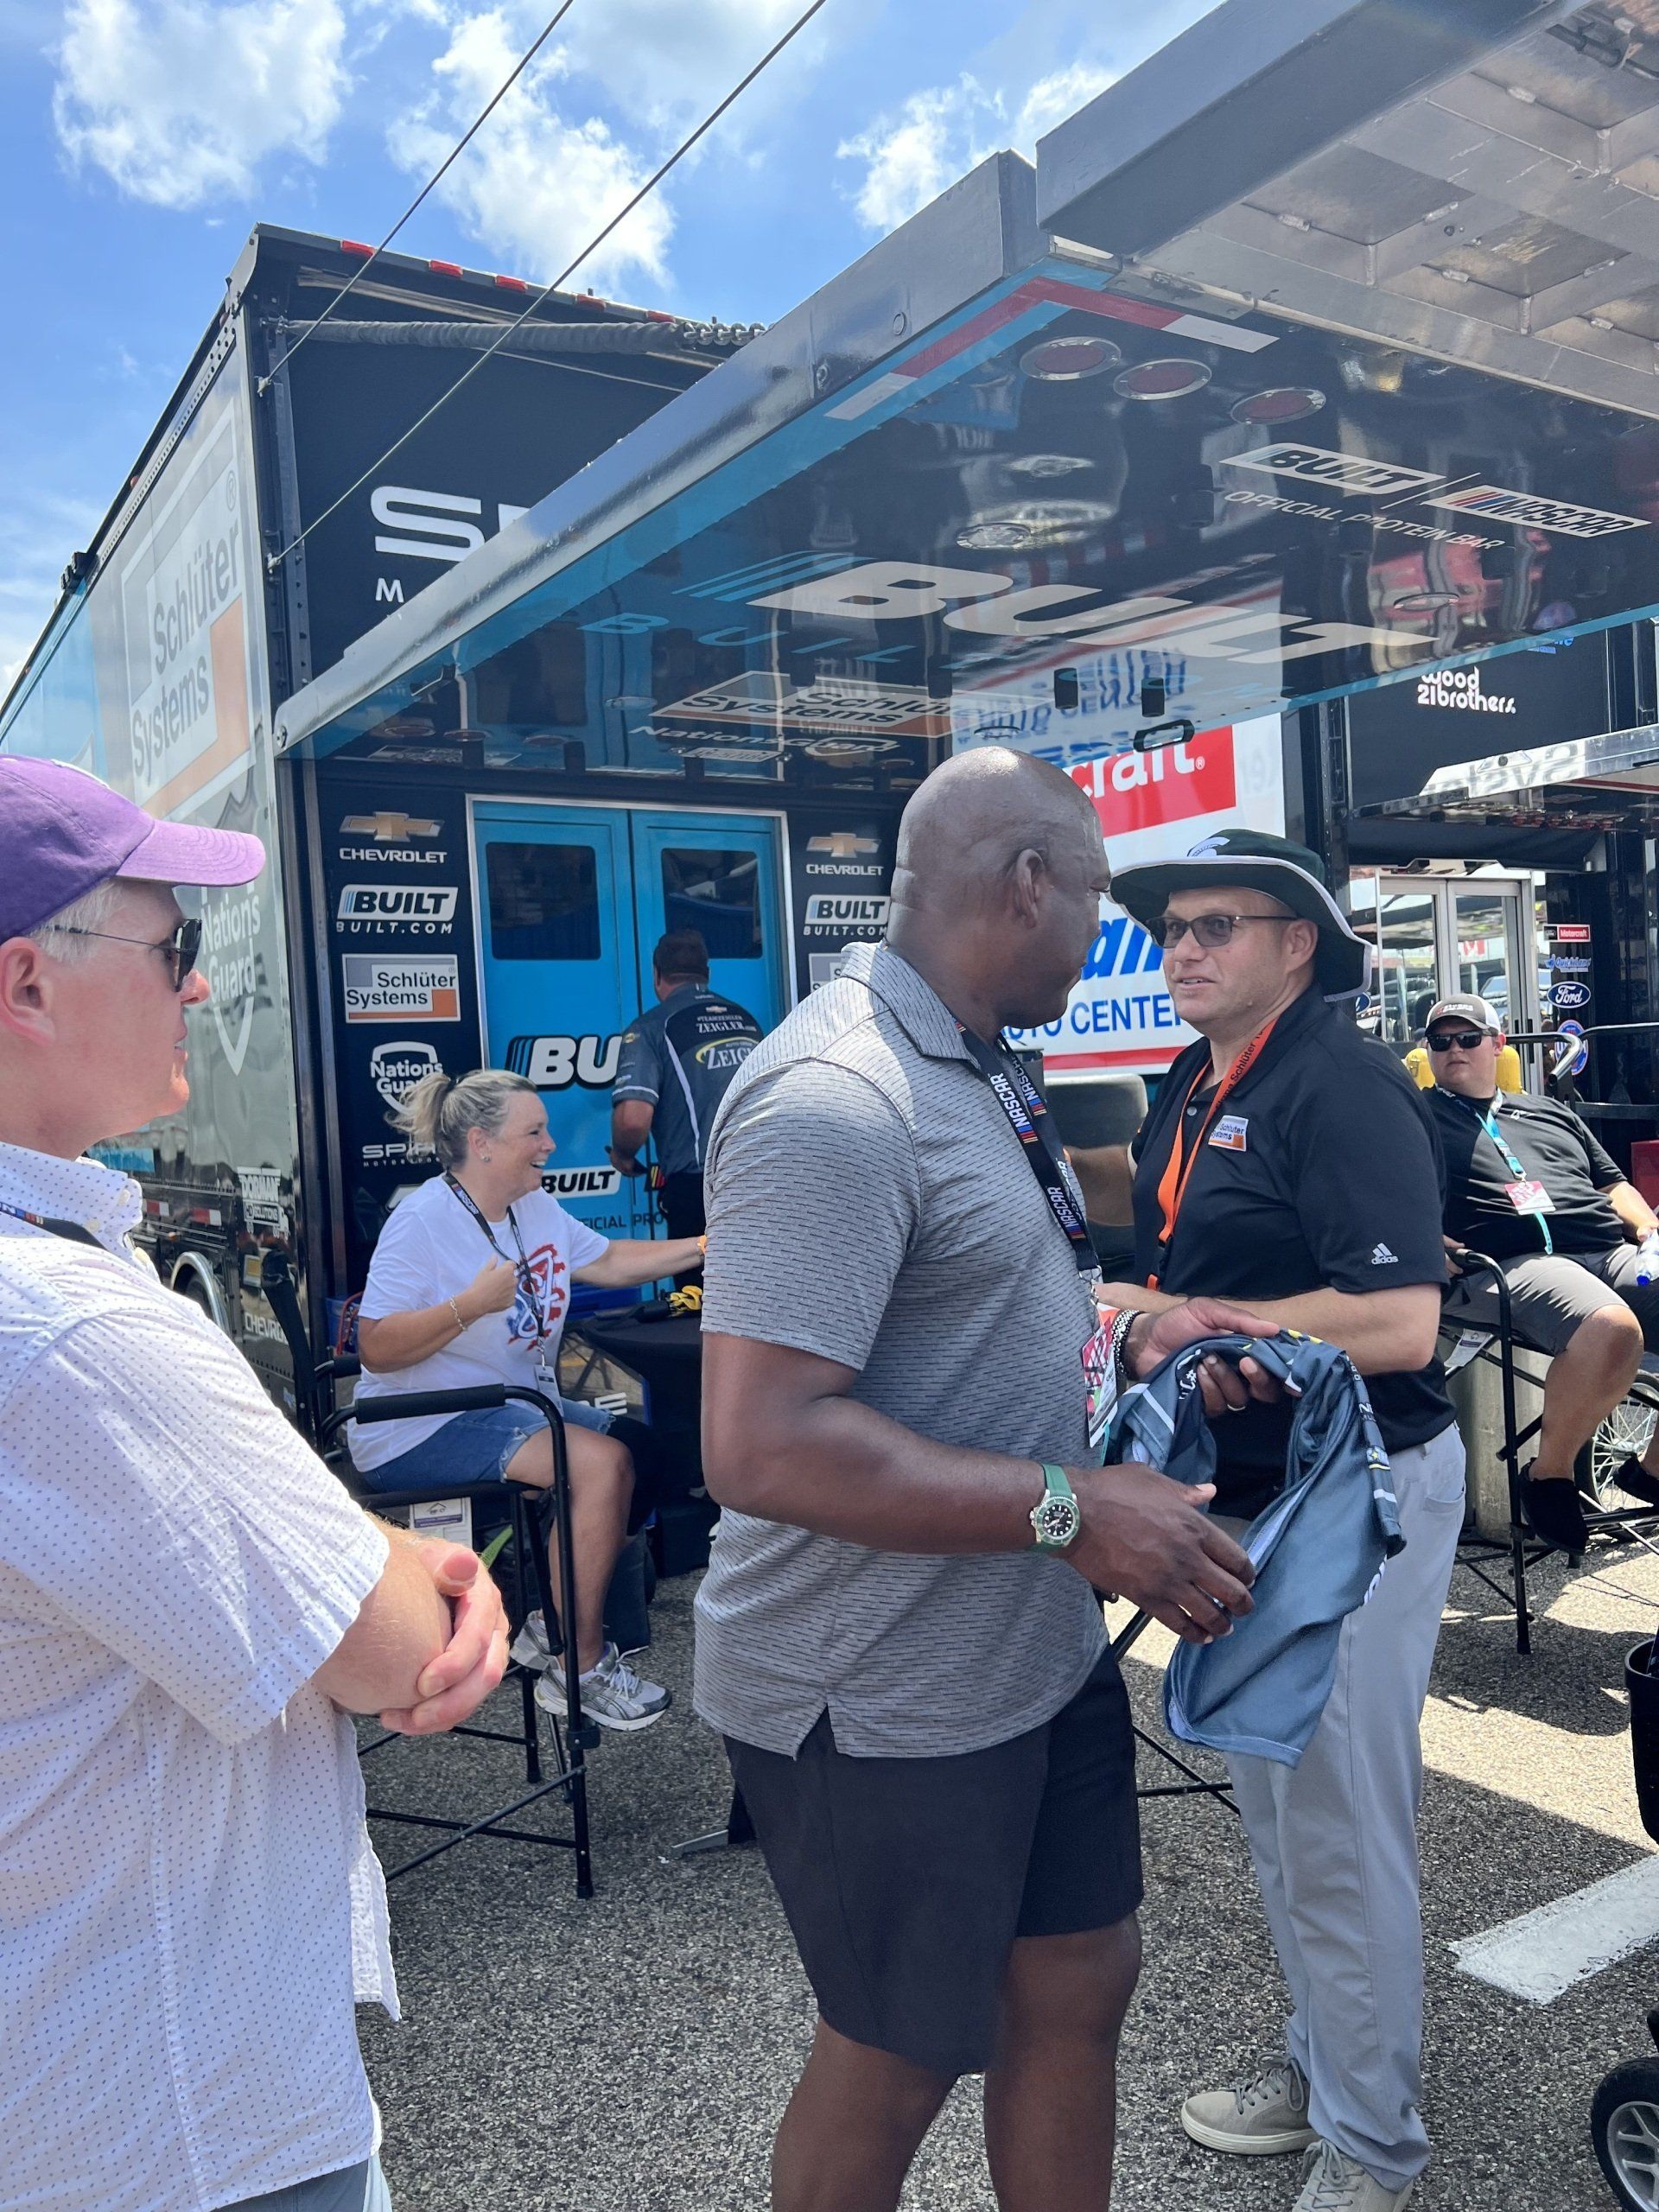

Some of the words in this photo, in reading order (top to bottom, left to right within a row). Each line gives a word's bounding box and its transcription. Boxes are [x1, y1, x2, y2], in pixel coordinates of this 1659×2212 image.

[1269, 449, 1422, 489] BUILT
[1224, 491, 1344, 520] OFFICIAL
[1343, 512, 1451, 543] PROTEIN
[1446, 530, 1506, 550] BAR
[1481, 499, 1636, 536] NASCAR
[154, 518, 239, 675] Schlüter
[746, 561, 1441, 664] BUILT
[131, 656, 209, 787] Systems
[682, 694, 905, 724] Systems
[340, 849, 448, 864] CHEVROLET
[806, 864, 884, 877] CHEVROLET
[353, 891, 450, 915] BUILT
[818, 899, 886, 920] BUILT
[201, 895, 260, 955] Nations
[336, 921, 454, 935] BUILT.COM
[804, 925, 887, 937] BUILT.COM
[209, 938, 256, 1003] Guard
[378, 972, 456, 988] Schlüter
[346, 990, 428, 1009] Systems
[1555, 984, 1583, 1004] Ford
[371, 1060, 443, 1077] Nations
[990, 1072, 1031, 1128] NASCAR
[240, 1173, 280, 1201] DORMAN
[542, 1171, 615, 1193] BUILT
[1047, 1186, 1079, 1228] NASCAR
[1371, 1255, 1399, 1265] adidas
